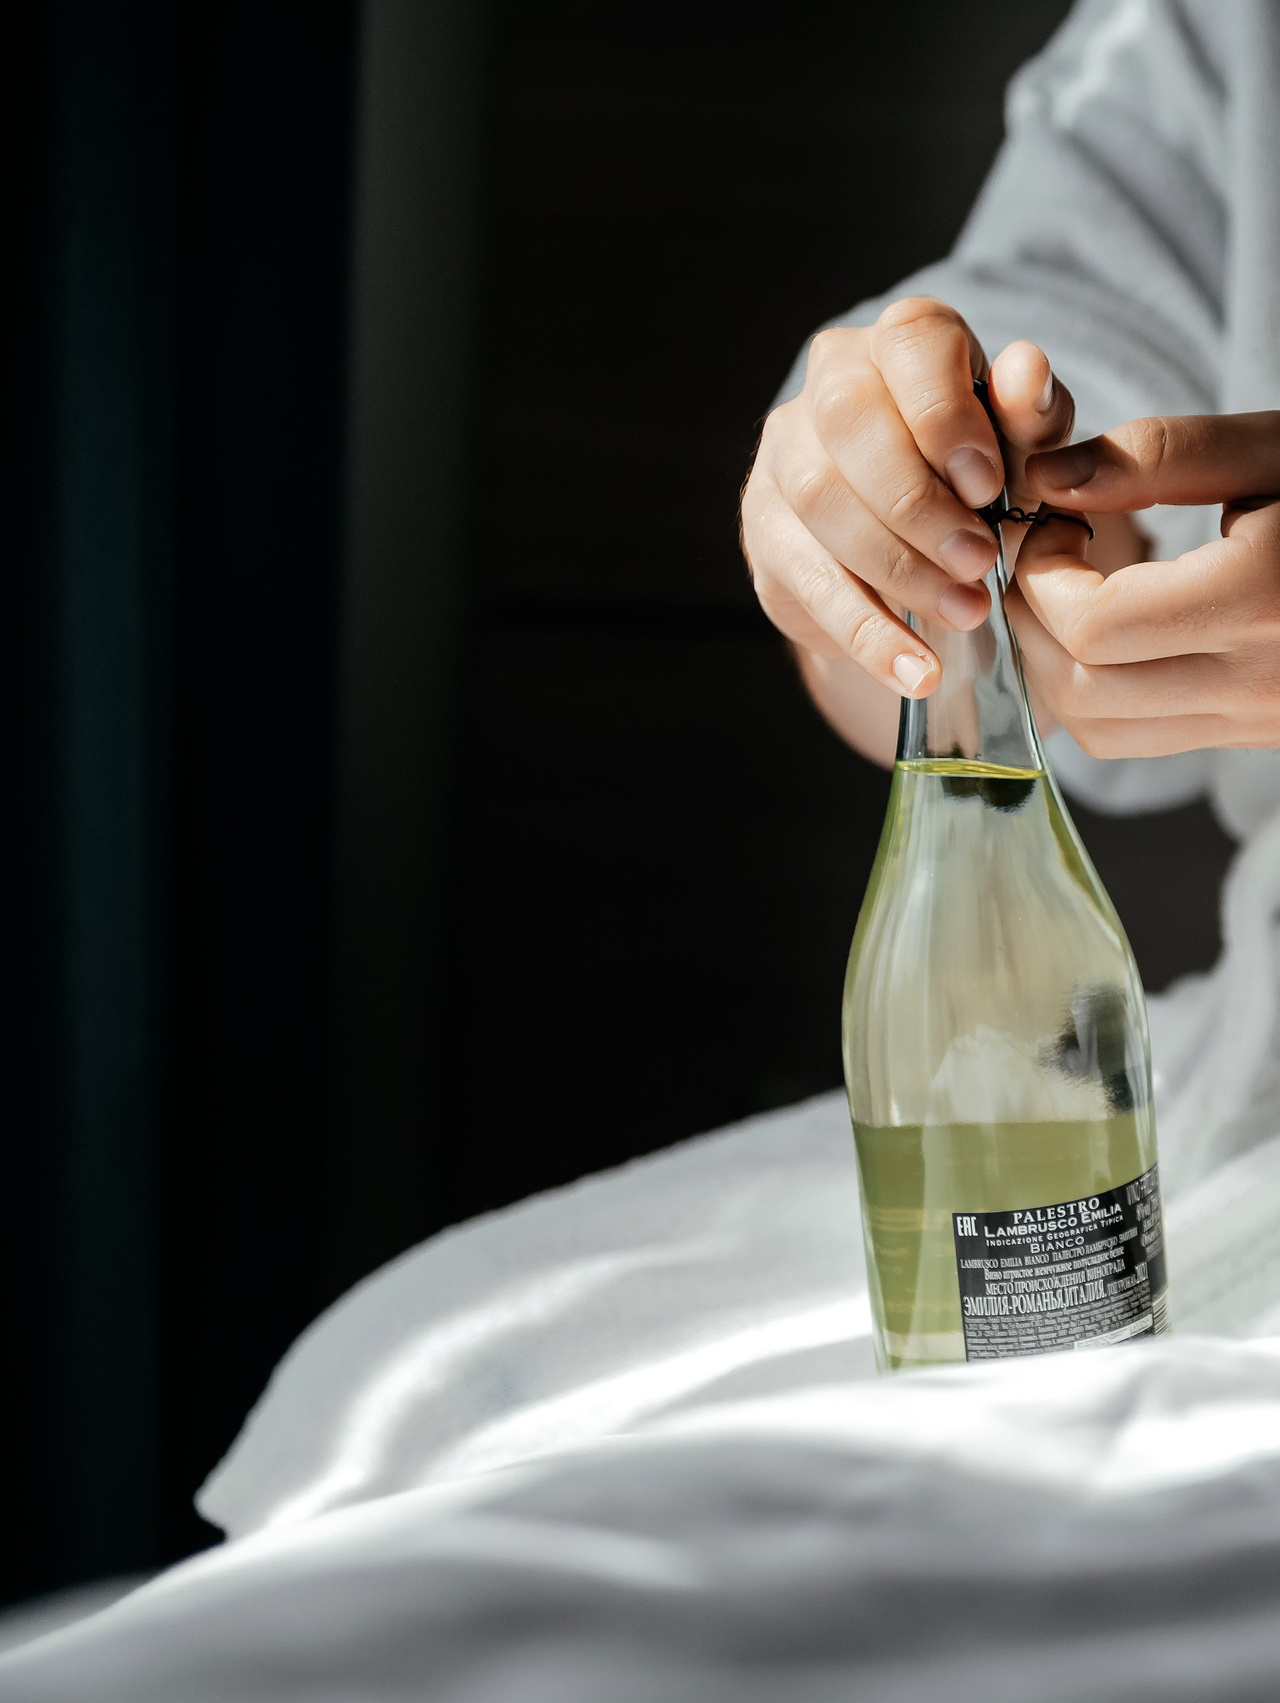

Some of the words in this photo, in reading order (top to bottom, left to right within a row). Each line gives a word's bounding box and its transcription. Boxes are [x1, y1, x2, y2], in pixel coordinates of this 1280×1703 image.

[984, 1218, 1078, 1238] LAMBRUSCO
[1081, 1203, 1122, 1225] EMILIA
[1013, 1197, 1100, 1225] PALESTRO
[957, 1216, 978, 1238] EAC
[986, 1236, 1044, 1247] INDICAZIONE
[1047, 1223, 1099, 1241] GEOGRAFICA
[1101, 1215, 1124, 1228] TIPICA
[1030, 1236, 1085, 1254] BIANCO
[960, 1259, 999, 1269] LAMBRUSCO
[1000, 1257, 1022, 1268] EMILIA
[1024, 1253, 1050, 1266] BIANCO
[985, 1280, 1014, 1296] МЕСТО
[1015, 1270, 1086, 1294] ПРОИСХОЖДЕНИЯ
[1086, 1259, 1126, 1281] ВИНОГРАДА
